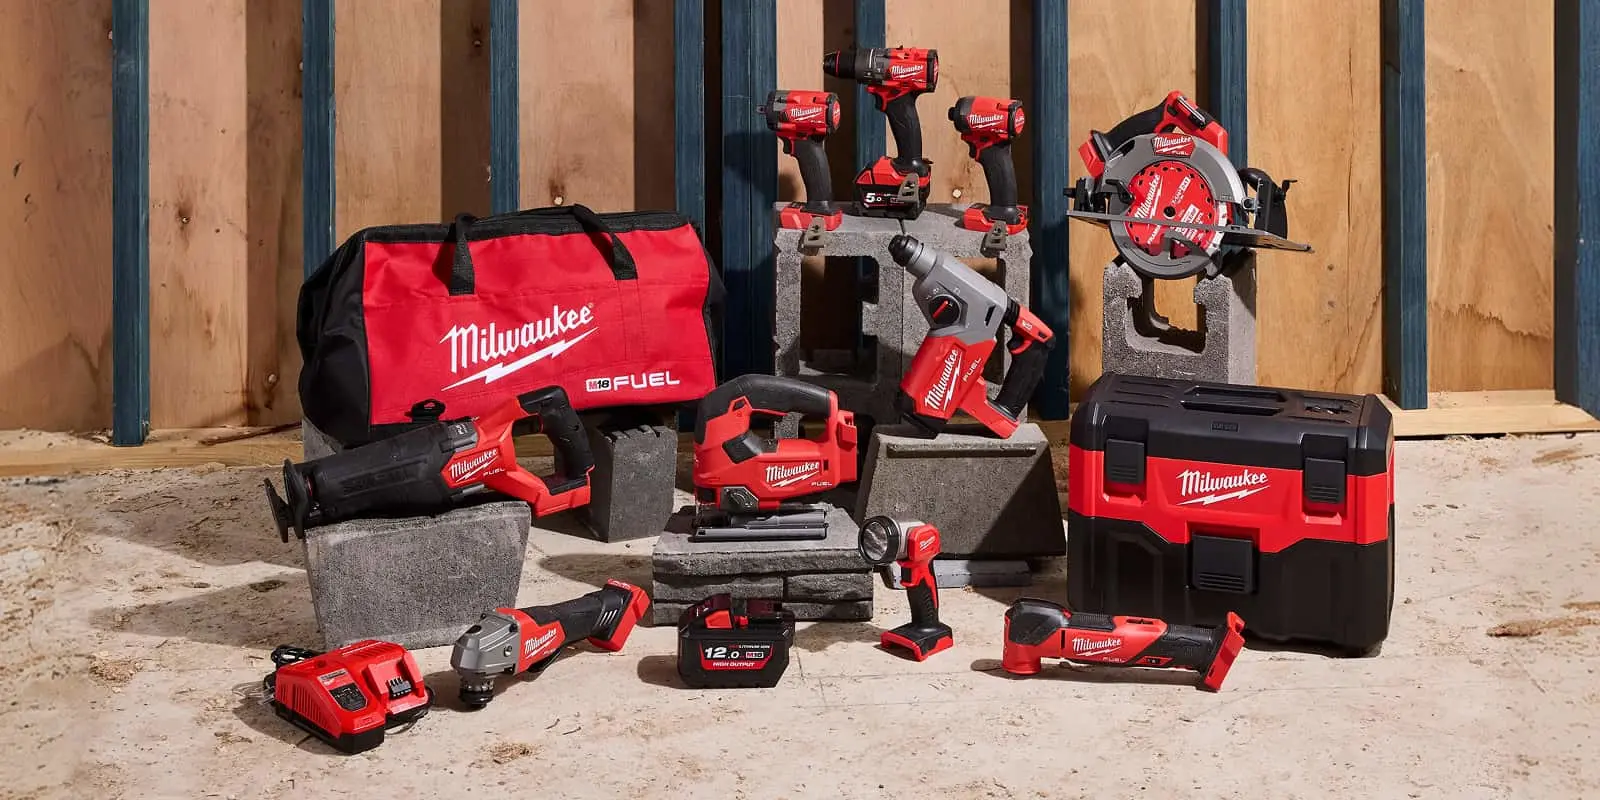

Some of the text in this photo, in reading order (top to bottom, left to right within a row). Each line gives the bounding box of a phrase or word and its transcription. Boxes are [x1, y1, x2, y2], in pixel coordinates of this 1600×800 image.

[892, 65, 923, 74] Milwaukee
[791, 107, 822, 117] Milwaukee
[969, 114, 1003, 125] Milwaukee
[1154, 136, 1191, 148] Milwaukee
[439, 304, 594, 374] Milwaukee
[924, 348, 959, 410] Milwaukee
[963, 358, 982, 382] FUEL
[587, 371, 680, 392] M18 FUEL
[451, 449, 497, 479] Milwaukee
[482, 468, 505, 477] FUEL
[765, 462, 820, 482] Milwaukee
[1176, 469, 1269, 497] Milwaukee
[525, 628, 557, 654] Milwaukee
[1072, 637, 1121, 652] Milwaukee
[705, 647, 740, 658] 12.0
